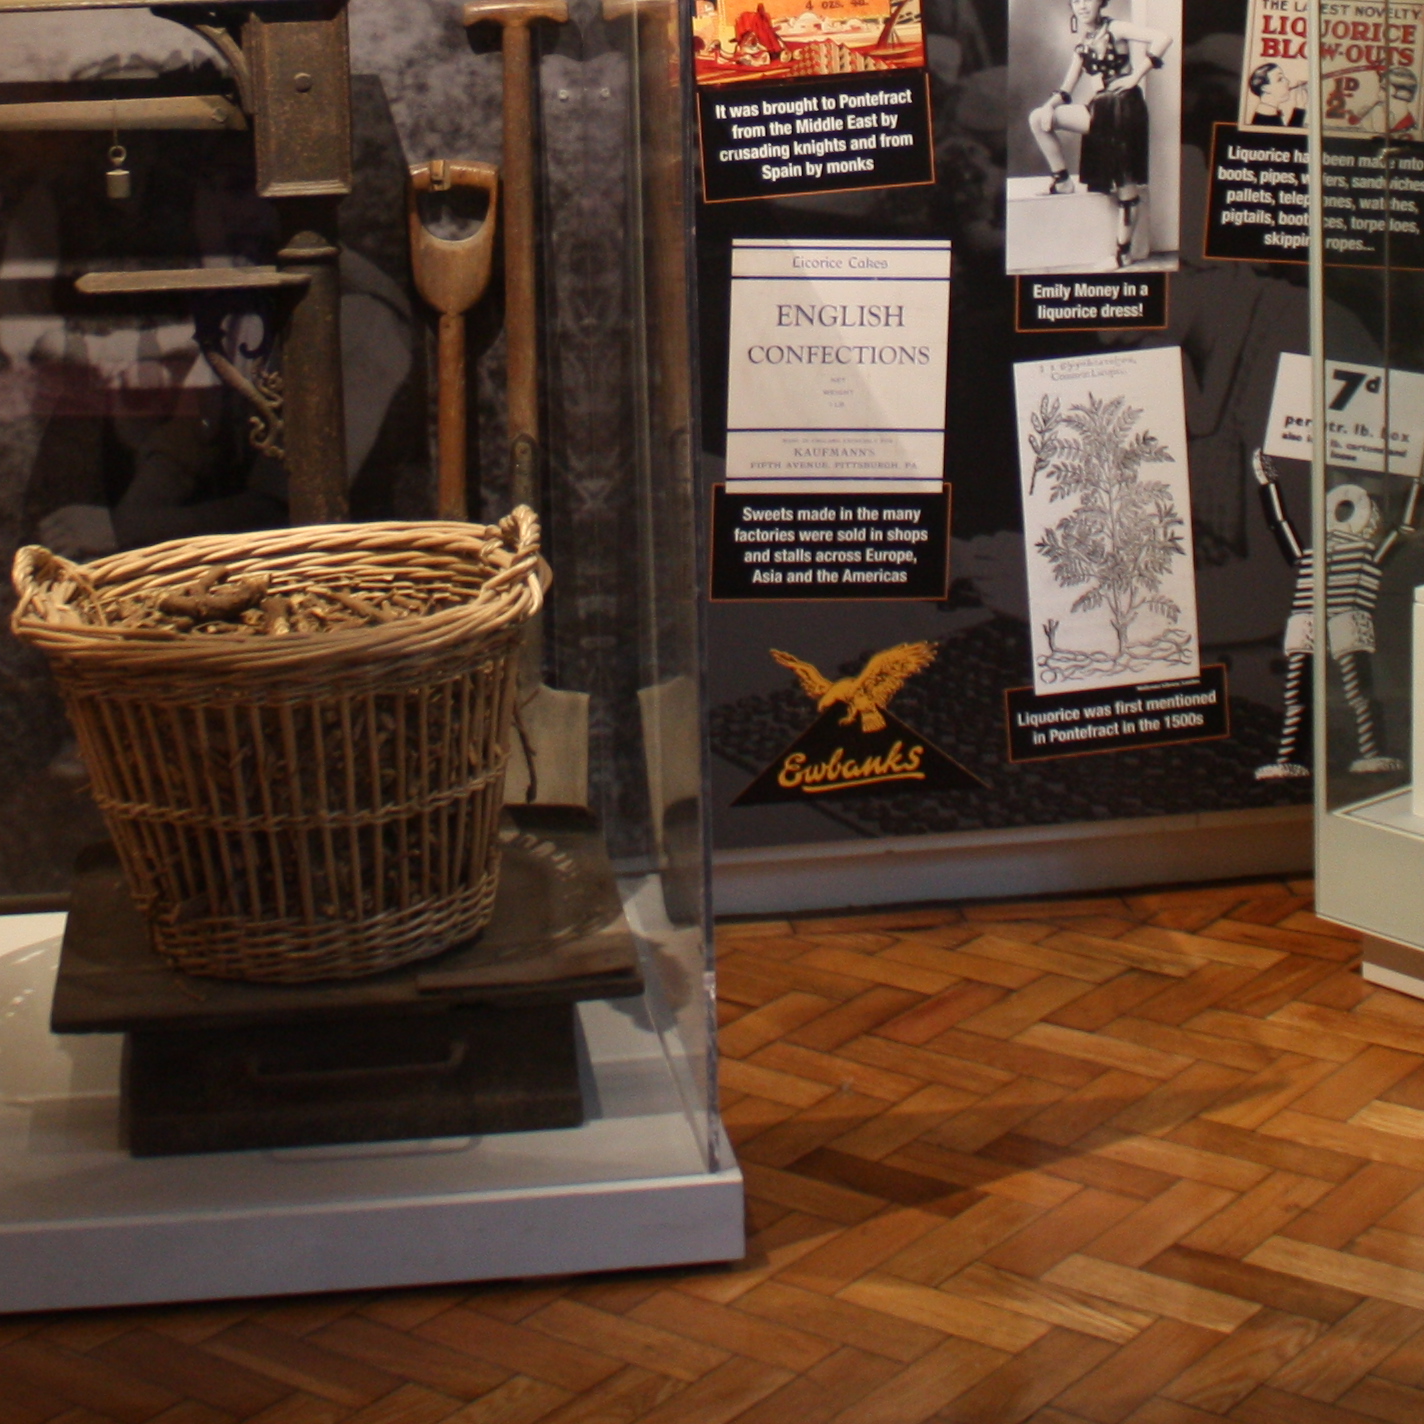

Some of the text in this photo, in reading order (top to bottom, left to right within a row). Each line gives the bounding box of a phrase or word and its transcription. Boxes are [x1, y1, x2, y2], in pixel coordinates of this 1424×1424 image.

[805, 0, 814, 11] 4
[1263, 0, 1422, 20] THE LAEST NOVELTY
[715, 89, 912, 119] It was brought to Pontefract
[731, 111, 897, 139] from the Middle East by
[719, 133, 913, 161] crusading knights and from
[761, 157, 873, 181] Spain by monks
[1033, 282, 1148, 300] Emily Money in a
[776, 304, 905, 327] ENGLISH
[1037, 303, 1142, 321] liquorice dress!
[747, 345, 931, 365] CONFECTIONS
[1285, 416, 1312, 429] per
[793, 448, 875, 457] KAUFMANN'S
[742, 506, 920, 522] Sweets made in the many
[734, 527, 927, 543] factories were sold in shops
[744, 547, 916, 564] and stalls across Europe,
[752, 568, 907, 583] Asia and the Americas
[1017, 690, 1216, 726] Liquorice was first mentioned
[1033, 712, 1203, 744] in Pontefract in the 1500s
[777, 743, 924, 787] Ewbanks
